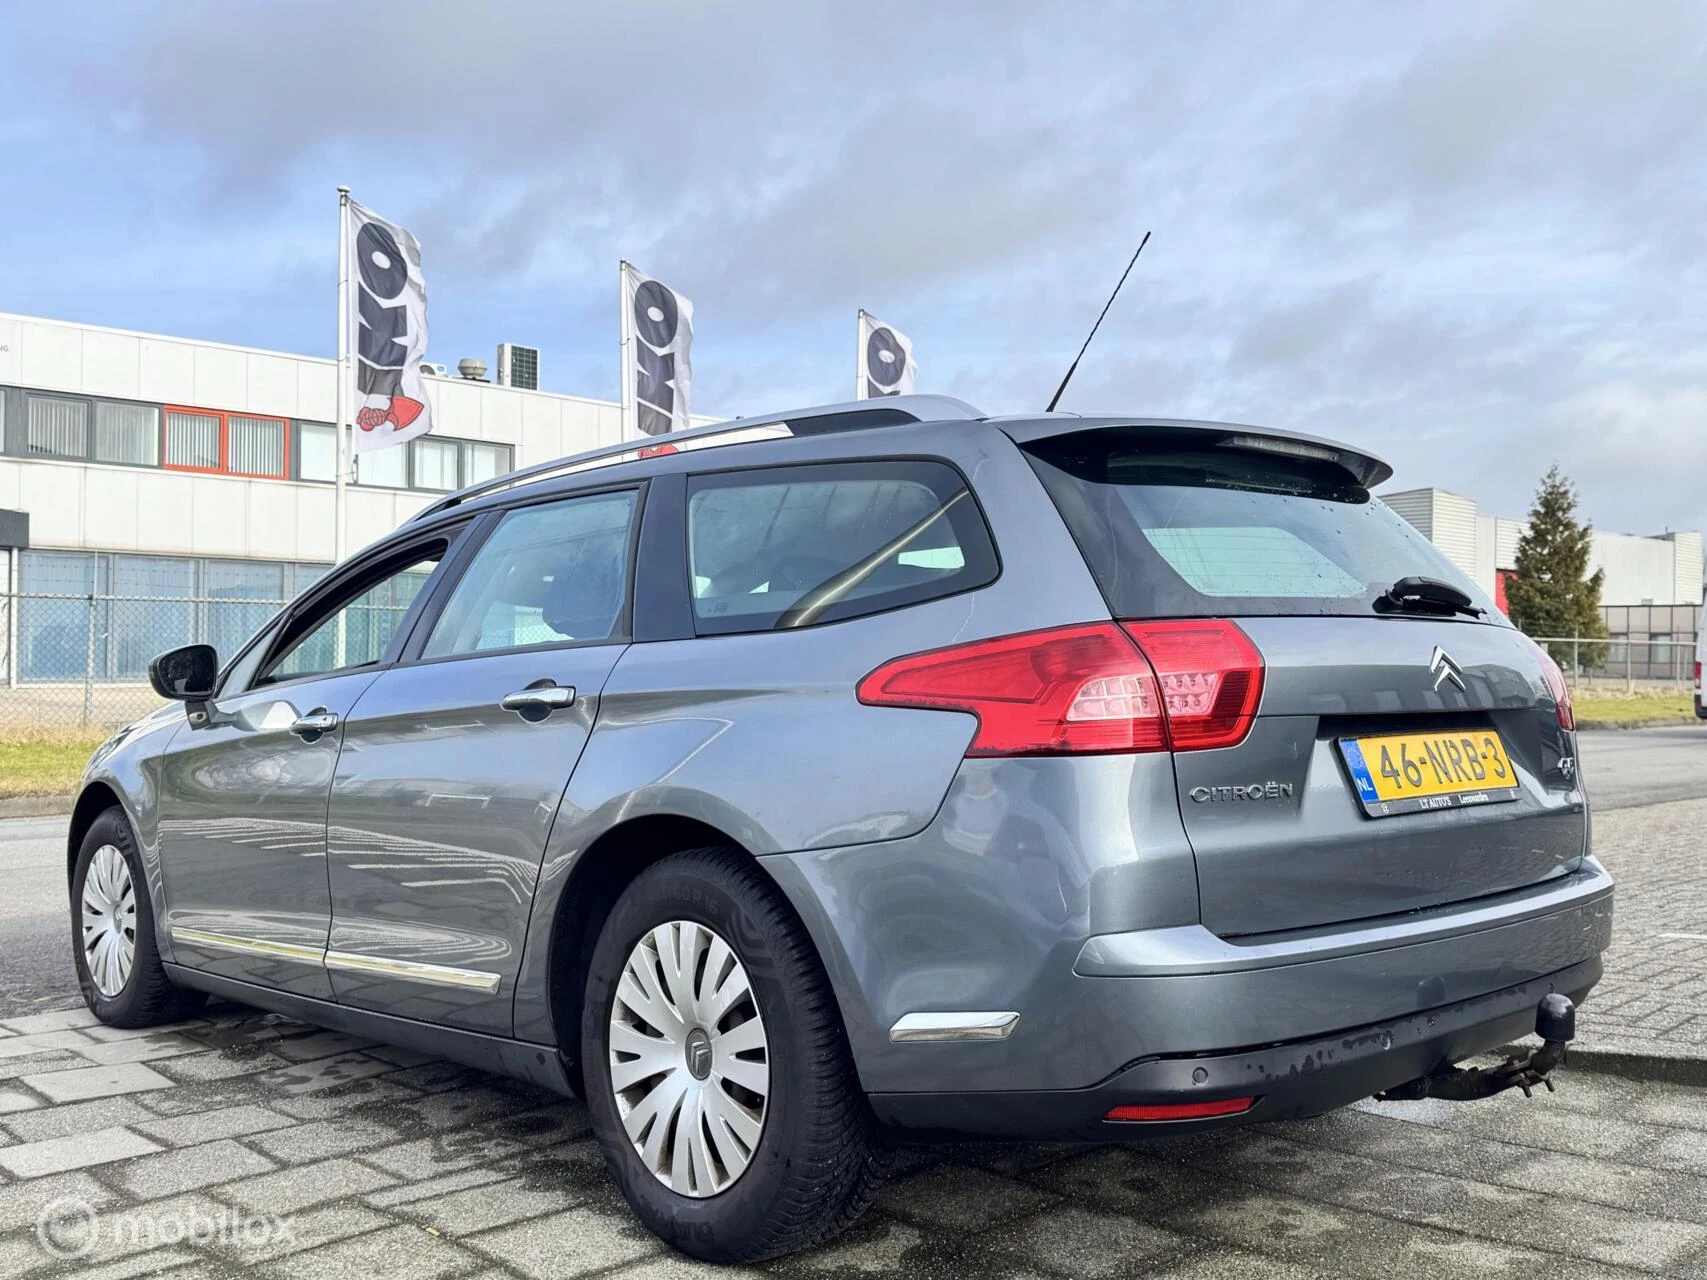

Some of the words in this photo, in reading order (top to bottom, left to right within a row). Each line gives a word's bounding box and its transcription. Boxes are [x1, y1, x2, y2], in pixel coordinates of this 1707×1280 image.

[356, 222, 408, 396] IKO
[634, 280, 678, 437] IKO
[1356, 777, 1374, 792] NL
[1380, 737, 1506, 789] 46-NRB-3
[1189, 781, 1293, 803] CITROËN
